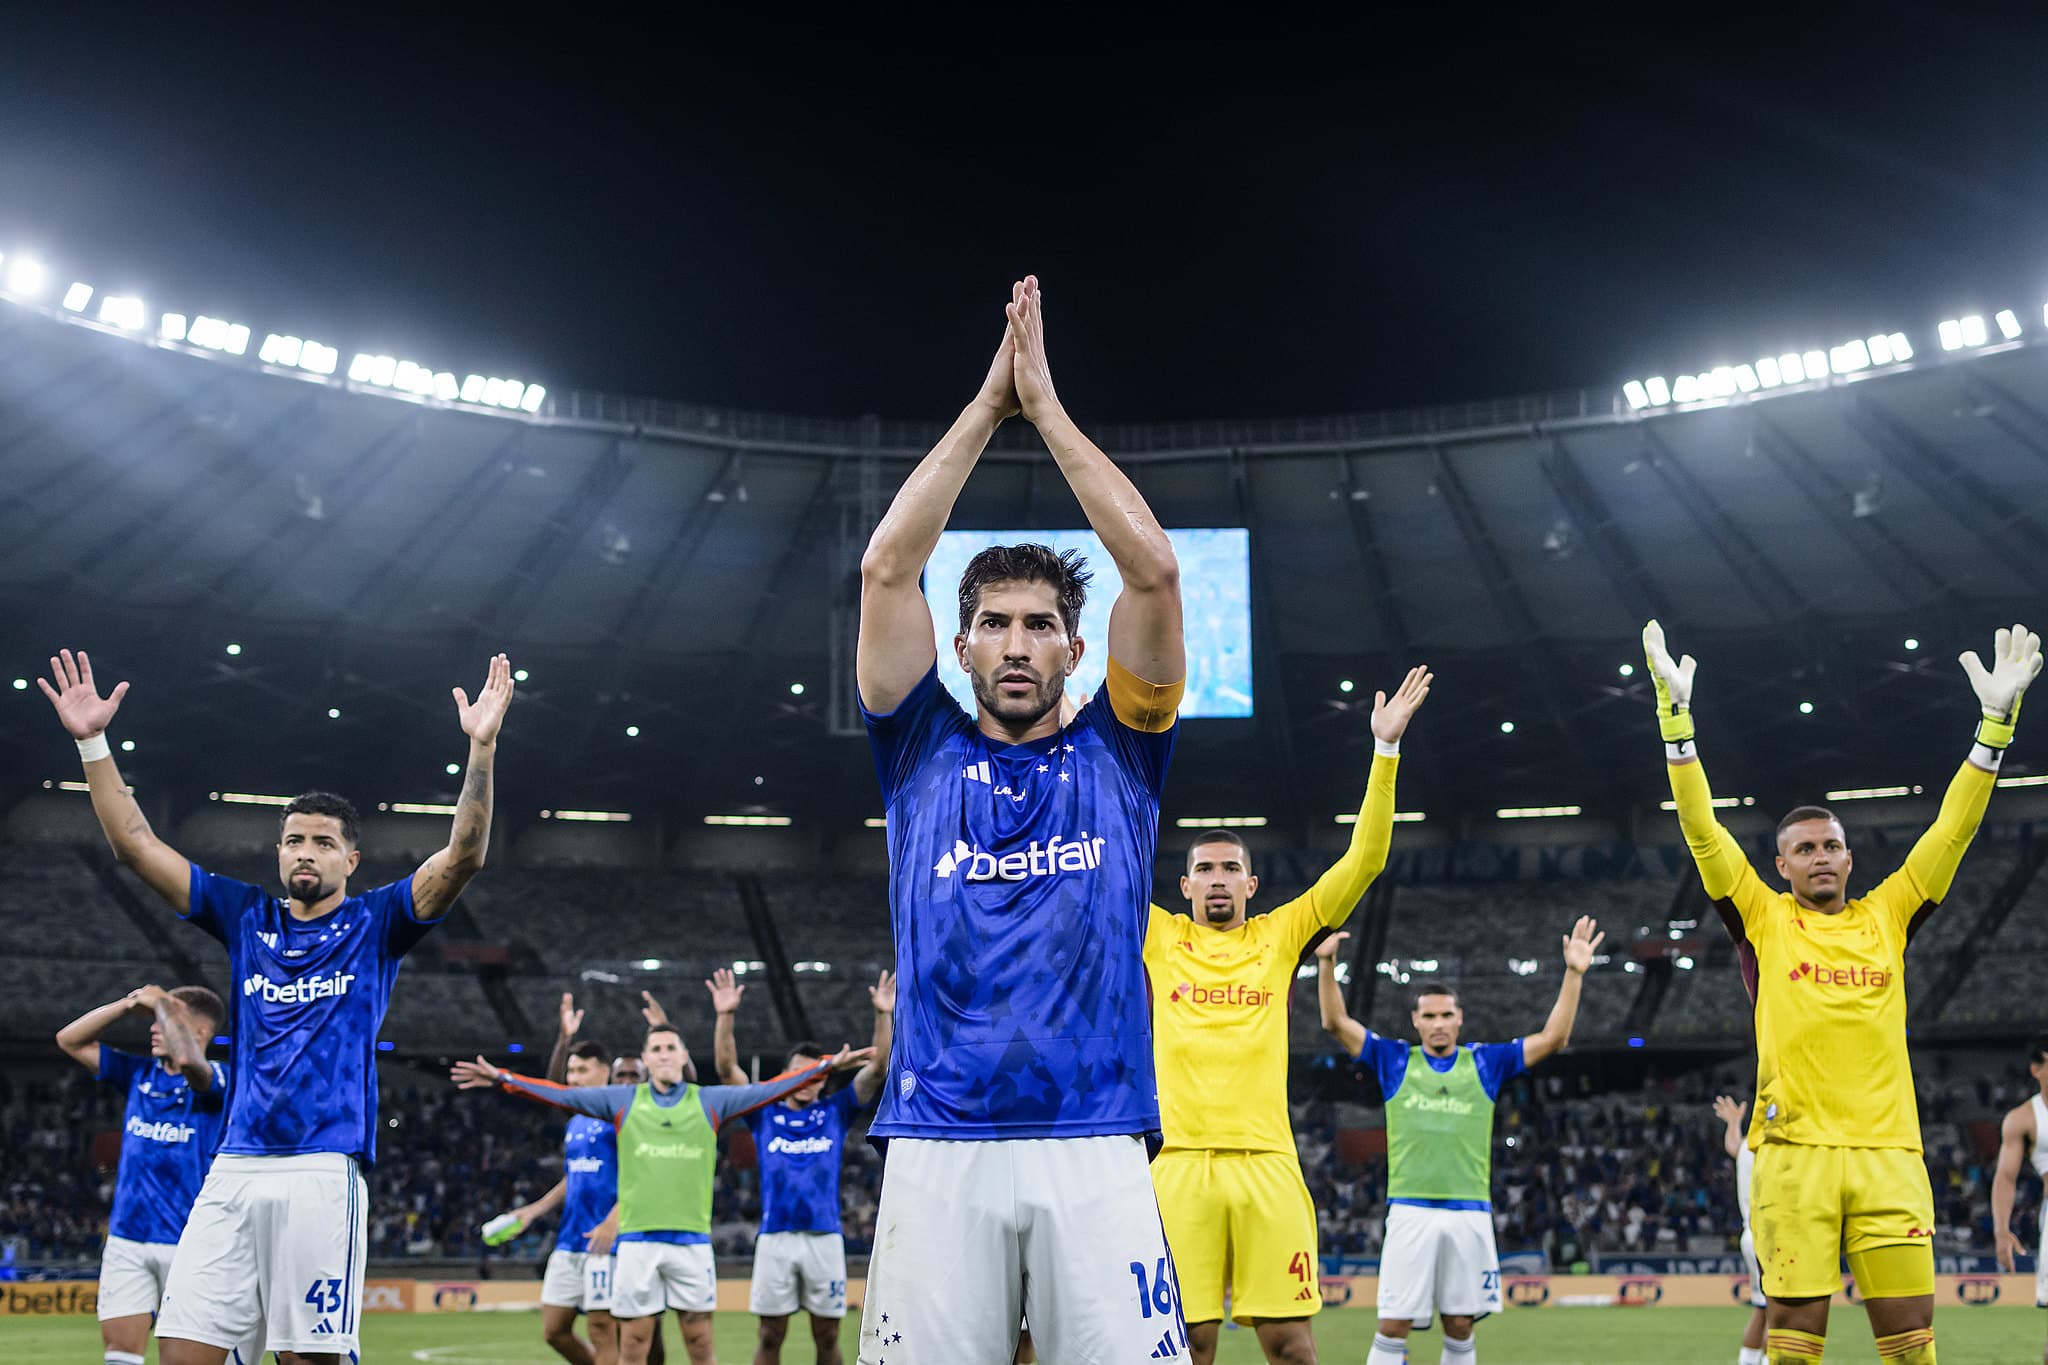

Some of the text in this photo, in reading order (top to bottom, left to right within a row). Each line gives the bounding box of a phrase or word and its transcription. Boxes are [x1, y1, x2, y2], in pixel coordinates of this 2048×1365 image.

[966, 831, 1106, 881] betfair
[263, 970, 355, 1003] betfair
[1814, 963, 1893, 988] betfair
[1192, 983, 1274, 1007] betfair
[1289, 1251, 1311, 1282] 41
[305, 1279, 342, 1313] 43
[1130, 1257, 1171, 1318] 16
